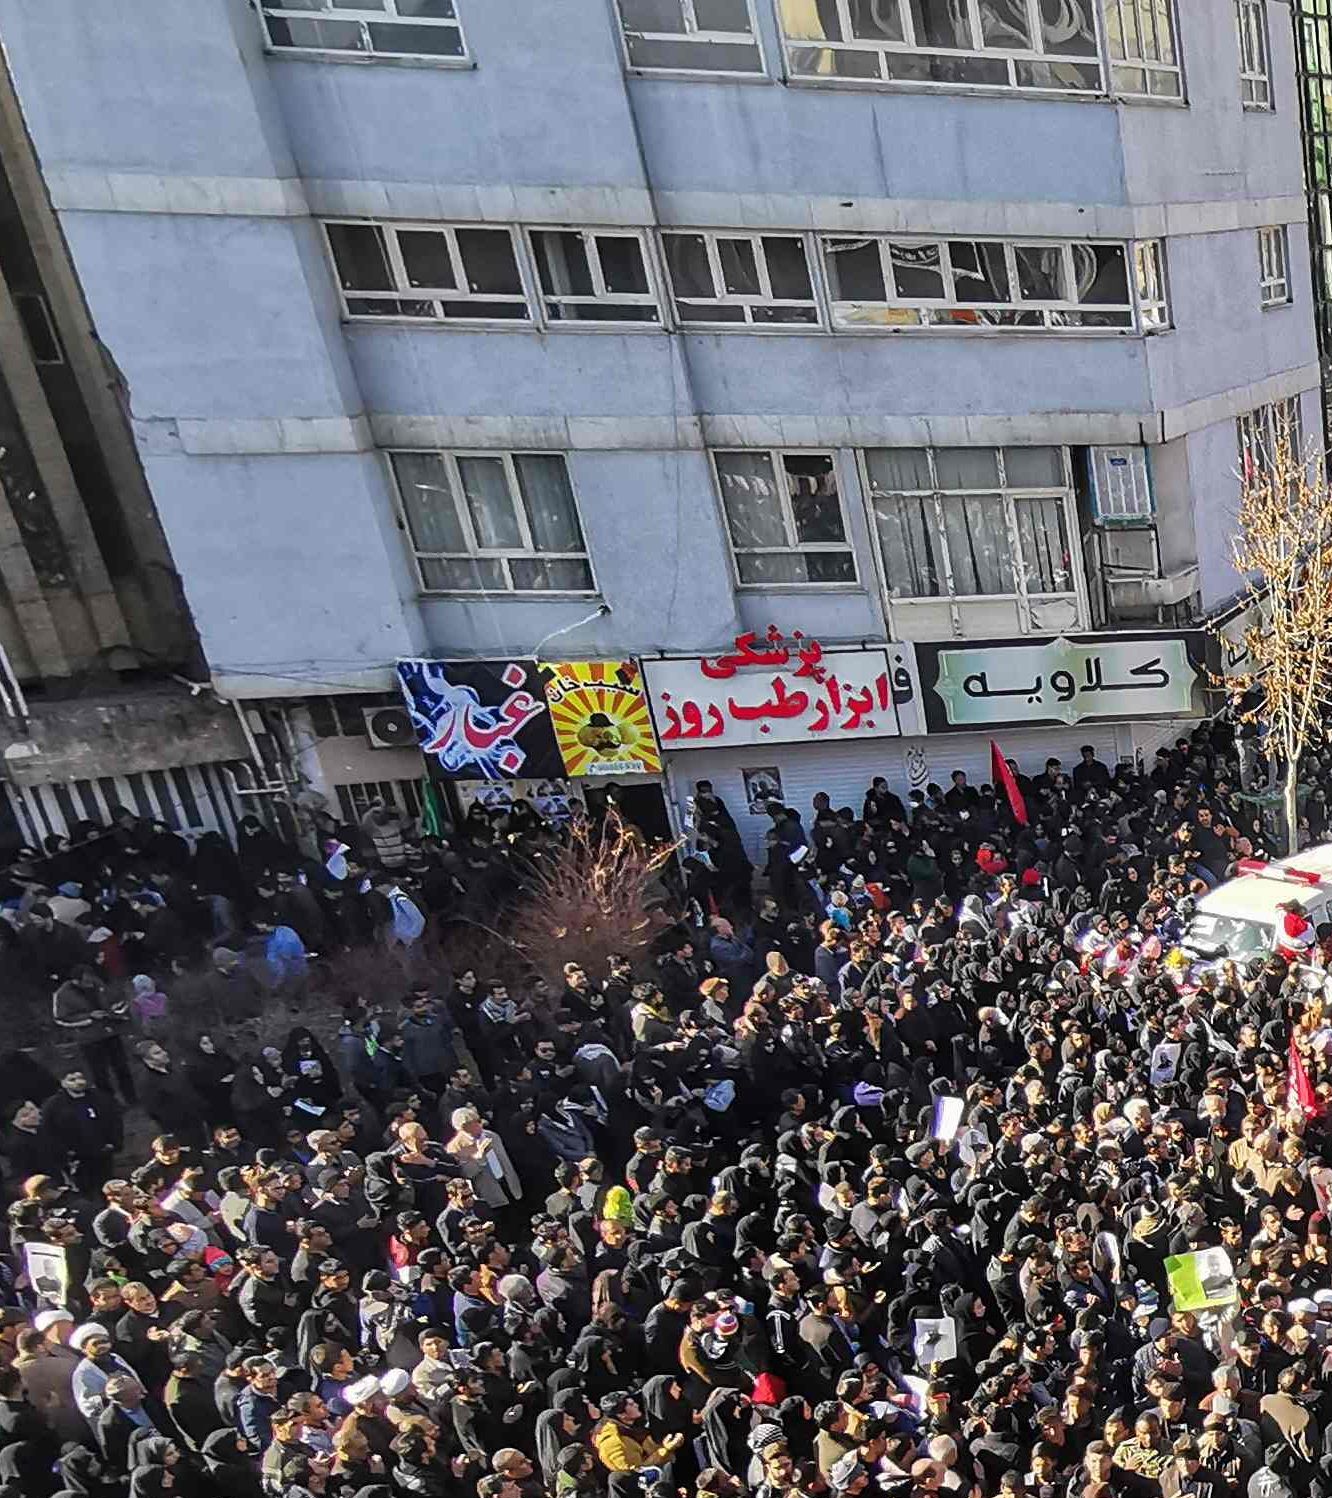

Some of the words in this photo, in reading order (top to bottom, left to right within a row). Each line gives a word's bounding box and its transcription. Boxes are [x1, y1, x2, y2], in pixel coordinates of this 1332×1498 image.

[701, 624, 827, 684] پزشکی
[962, 657, 1170, 703] کلاویه
[424, 663, 547, 776] غبار
[660, 692, 726, 740] روز
[727, 676, 810, 734] طب
[808, 672, 889, 732] ابزار
